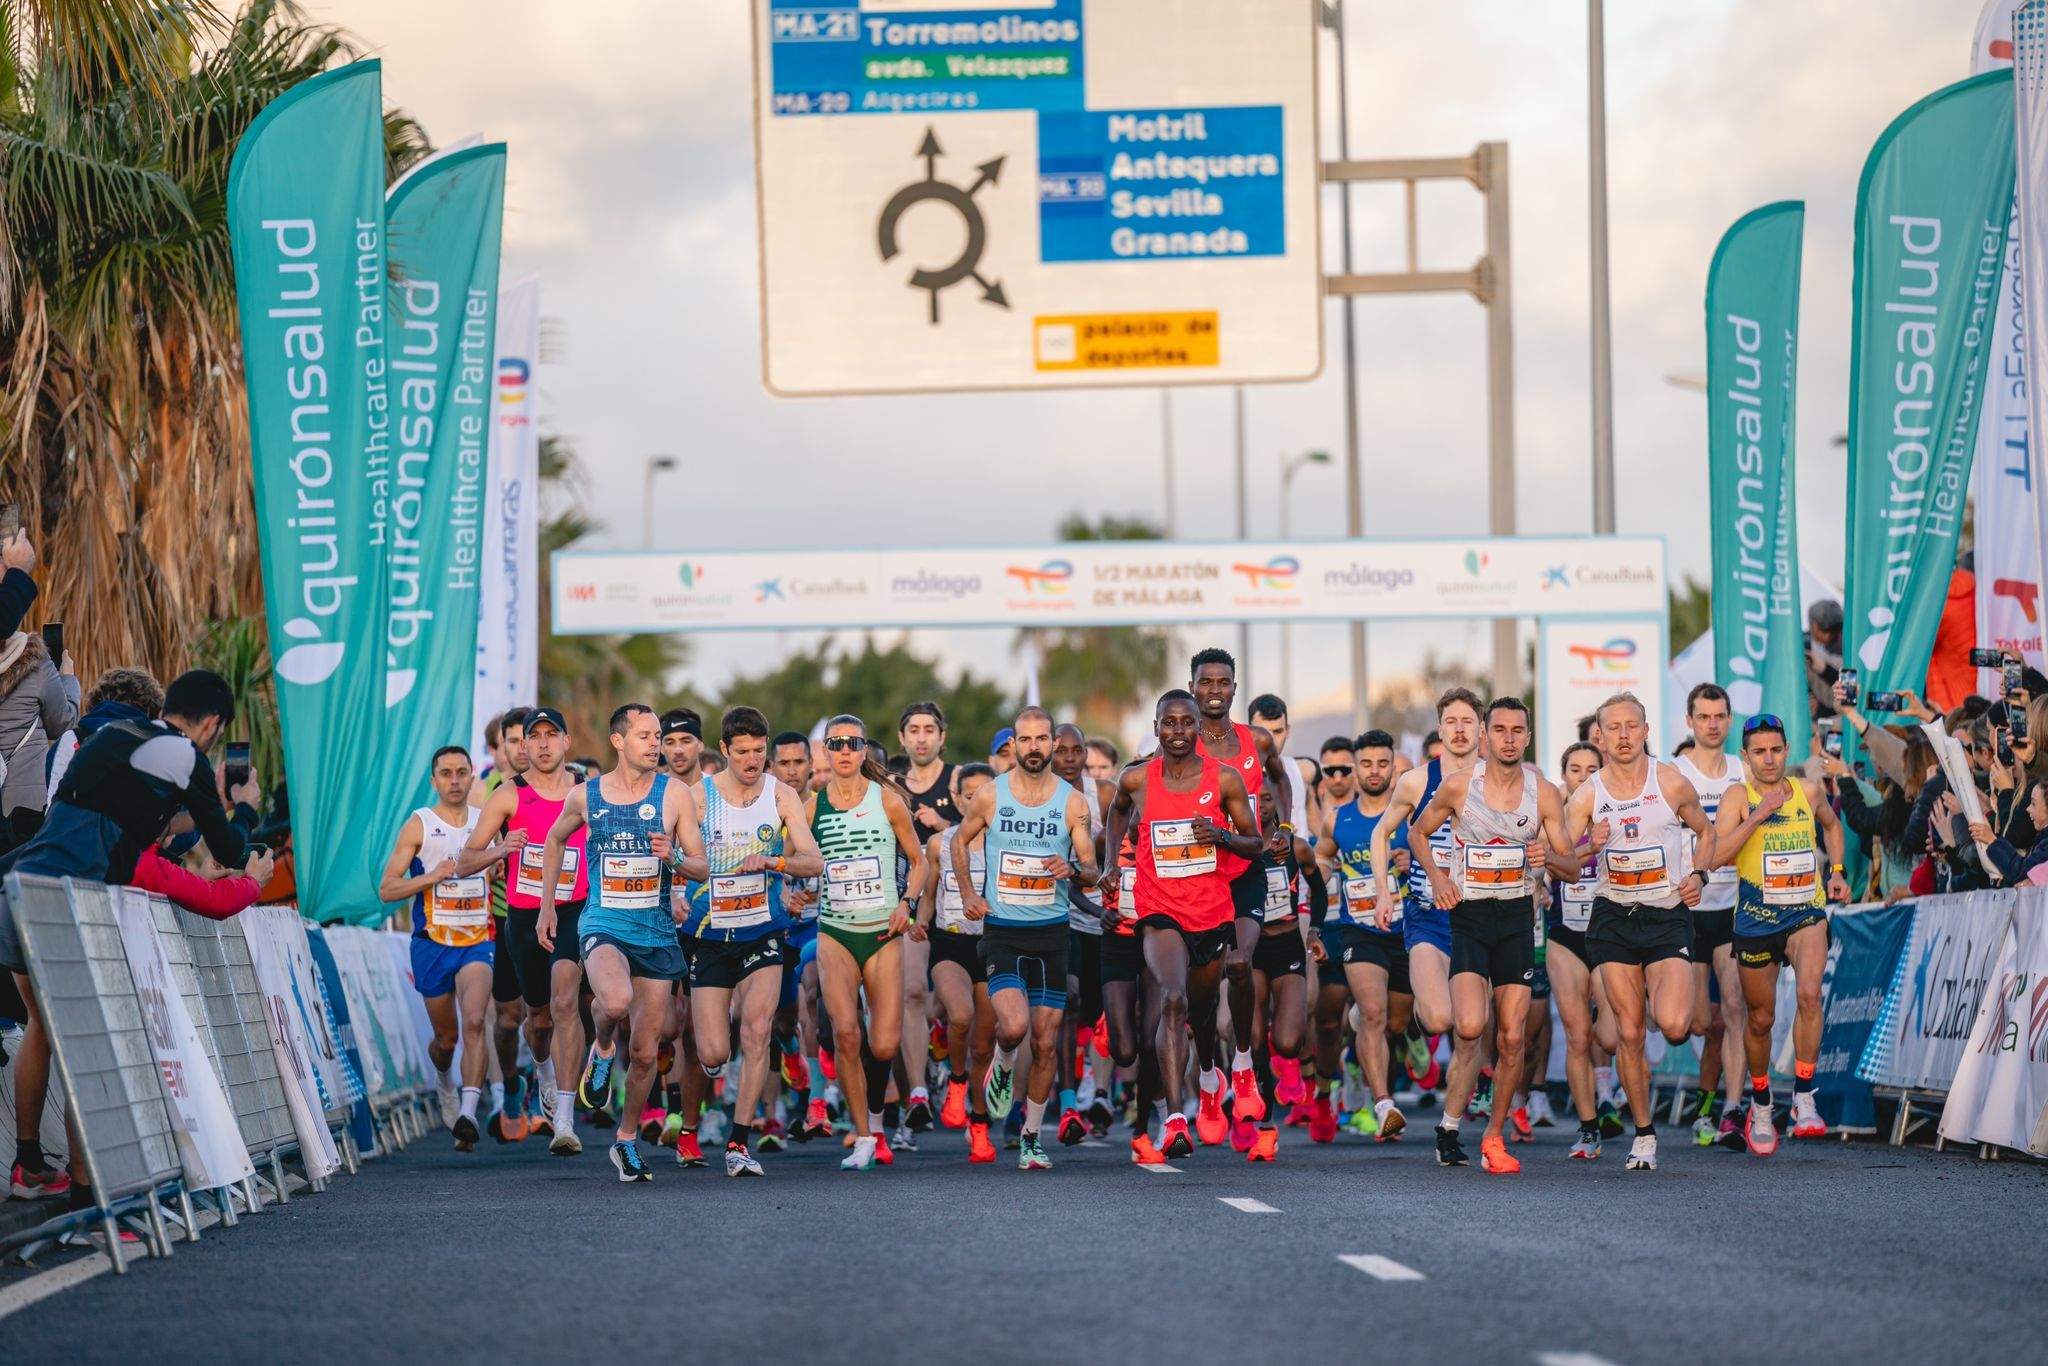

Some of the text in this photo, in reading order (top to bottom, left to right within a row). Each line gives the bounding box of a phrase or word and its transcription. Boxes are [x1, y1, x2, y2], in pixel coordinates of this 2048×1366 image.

[775, 11, 857, 38] MA-21
[865, 16, 1079, 46] Torremolinos
[866, 57, 935, 79] avda.
[1108, 113, 1208, 142] Motril
[1111, 152, 1280, 184] Antequera
[1111, 187, 1224, 218] Sevilla
[1111, 226, 1250, 256] Granada
[1963, 219, 2002, 349] Partner
[356, 216, 390, 546] Healthcare Partner
[262, 217, 358, 617] quirónsalud
[1880, 215, 1942, 603] quirónsalud
[448, 289, 488, 590] Healthcare Partner
[387, 279, 440, 648] quirónsalud
[1727, 314, 1769, 661] quirónsalud
[999, 817, 1058, 839] nerja
[1763, 832, 1800, 842] CANILLAS
[597, 840, 651, 851] ARBELL
[1008, 838, 1051, 849] ATLETISMO
[1180, 845, 1191, 860] 4
[1763, 840, 1812, 852] ALBAIDA
[624, 878, 643, 892] 66
[1019, 877, 1038, 890] 67
[1494, 870, 1503, 884] 2
[1633, 871, 1643, 885] 7
[1786, 874, 1804, 887] 47
[844, 881, 872, 897] F15
[455, 899, 471, 911] 46
[734, 897, 752, 911] 23
